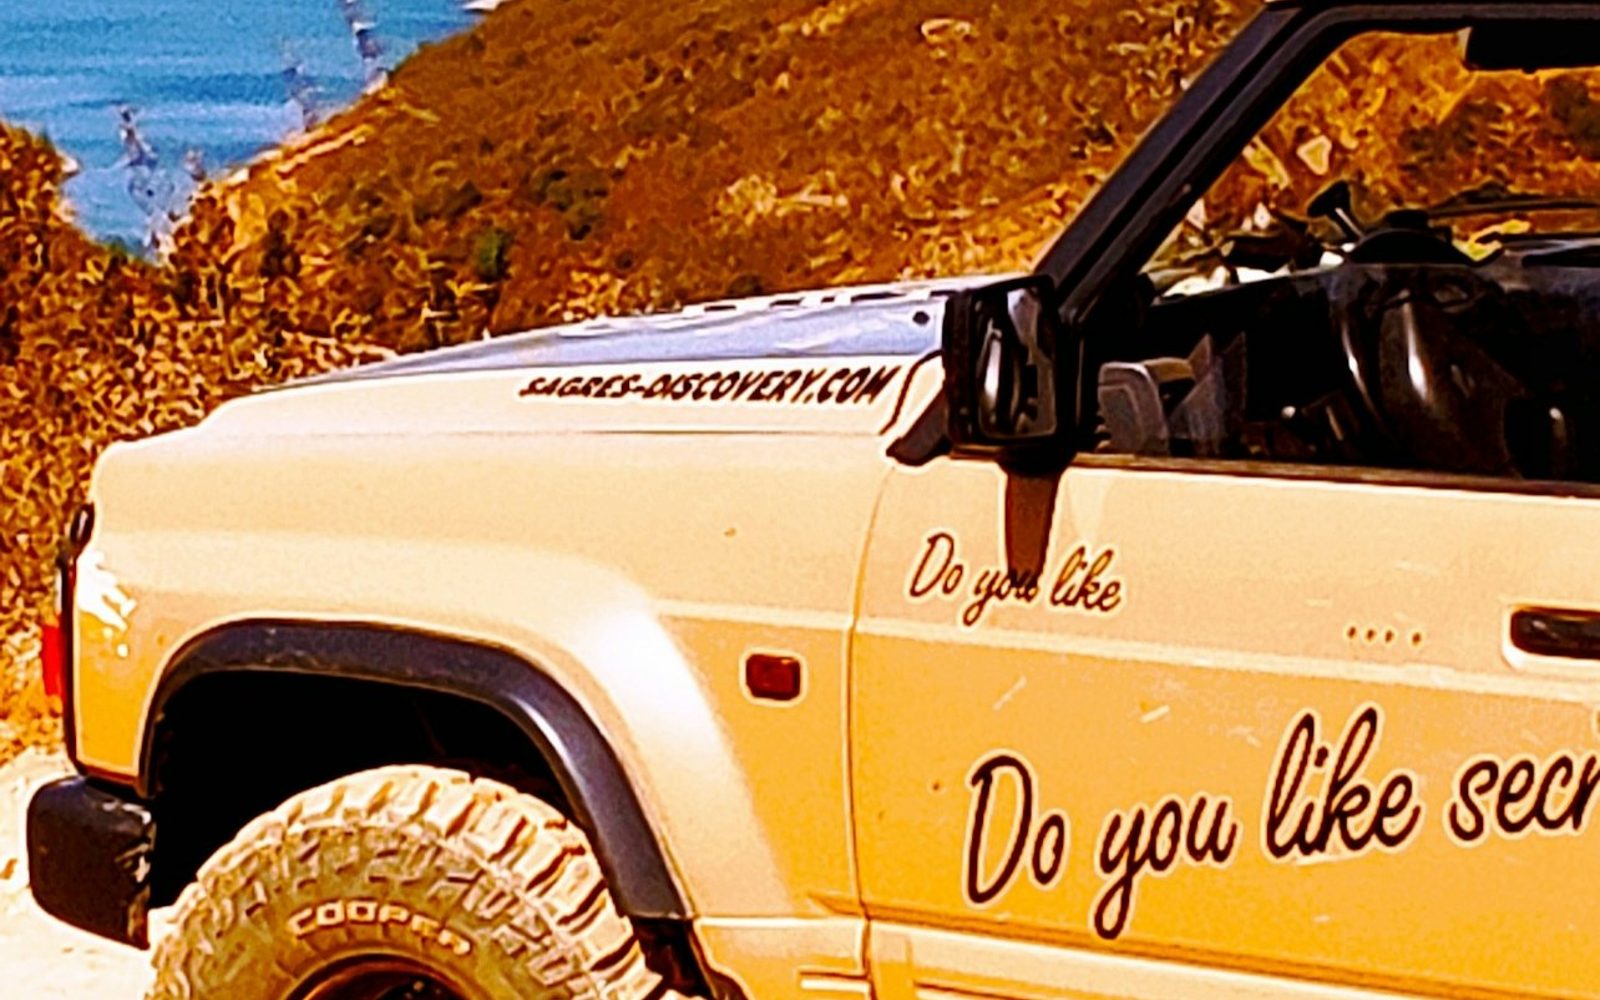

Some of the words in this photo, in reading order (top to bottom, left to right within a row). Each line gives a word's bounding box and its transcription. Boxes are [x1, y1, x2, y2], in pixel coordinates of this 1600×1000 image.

[518, 365, 902, 404] SAGRES-DISCOVERY.COM
[909, 532, 964, 597] Do
[963, 569, 1039, 626] you
[1050, 545, 1122, 612] like
[967, 755, 1064, 904] Do
[1095, 796, 1237, 940] you
[1265, 707, 1422, 861] like
[286, 899, 471, 955] COOPER
